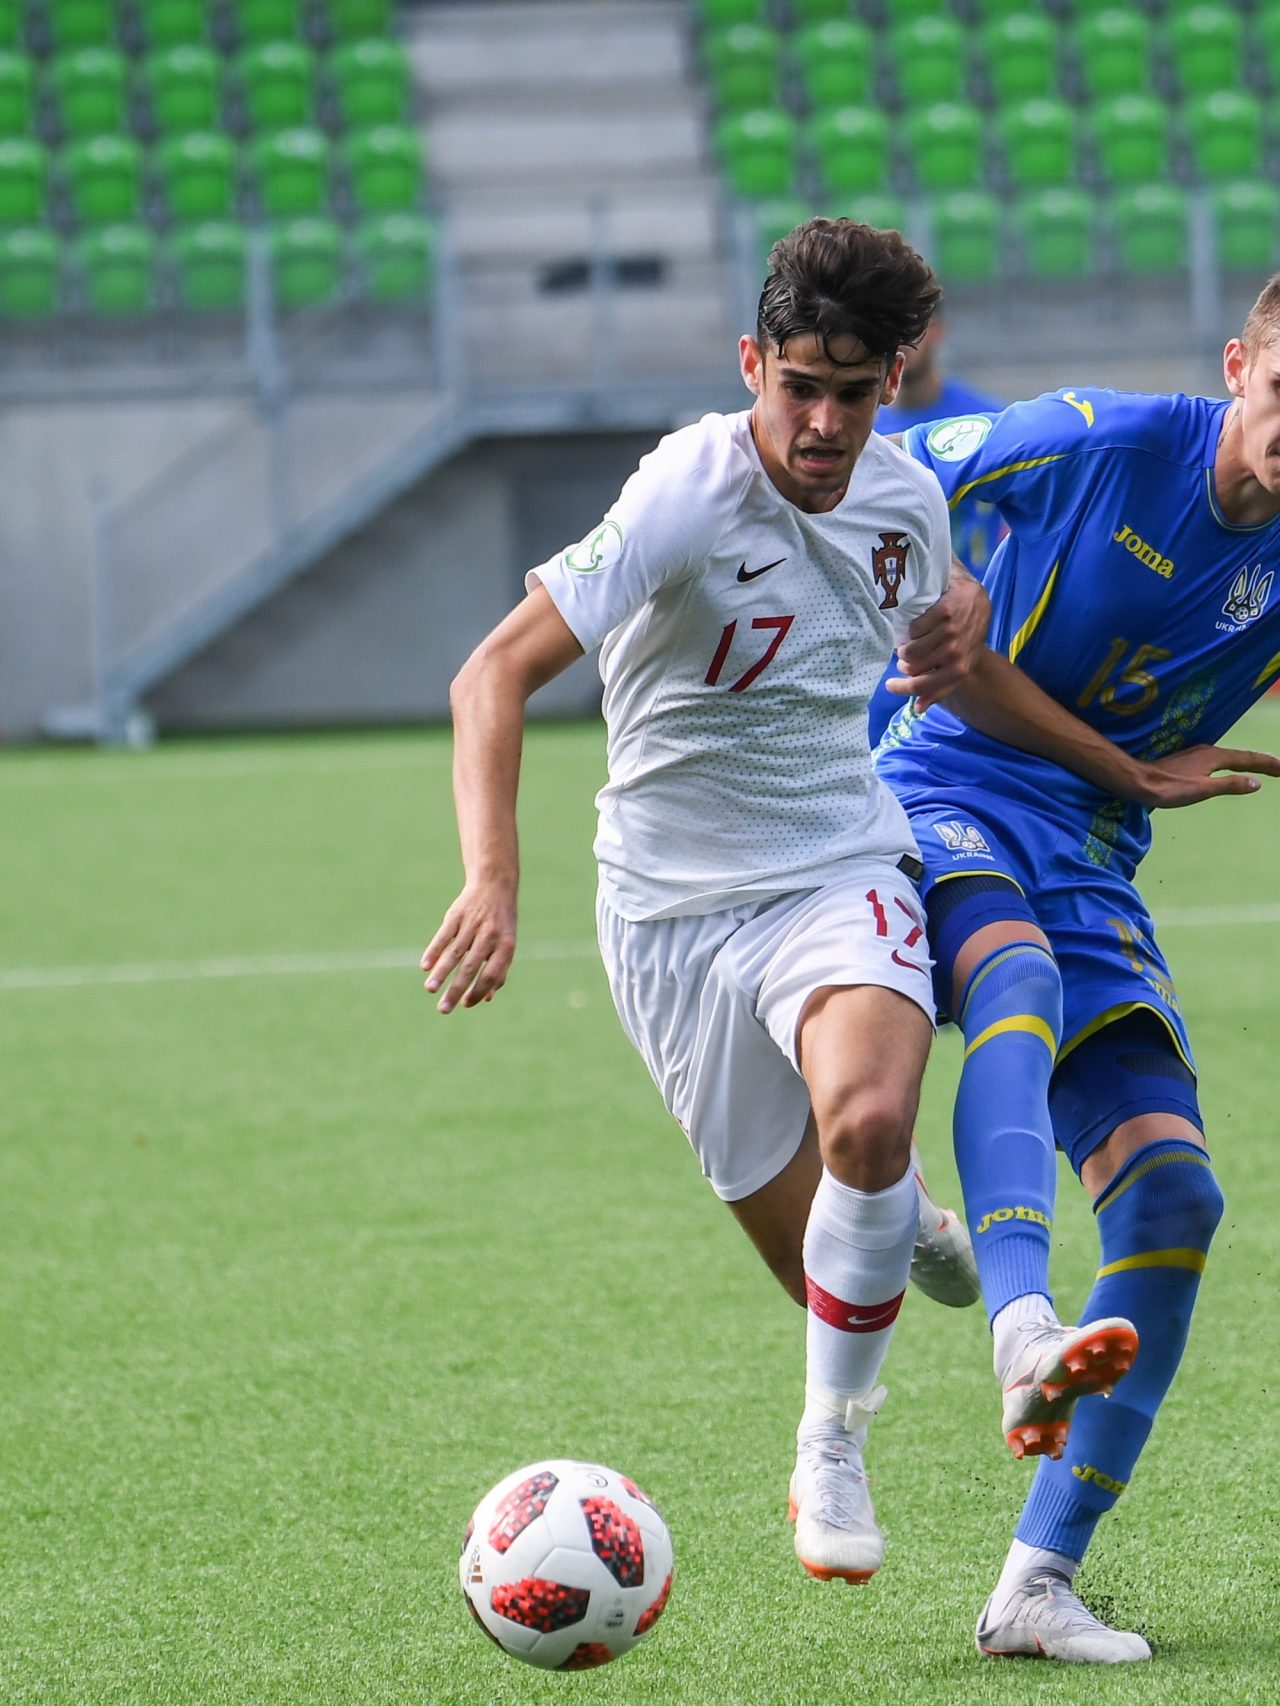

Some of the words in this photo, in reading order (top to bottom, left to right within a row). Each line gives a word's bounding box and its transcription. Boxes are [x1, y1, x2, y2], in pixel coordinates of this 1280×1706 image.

[1113, 524, 1176, 580] Joma
[704, 614, 796, 694] 17
[1077, 637, 1173, 716] 15
